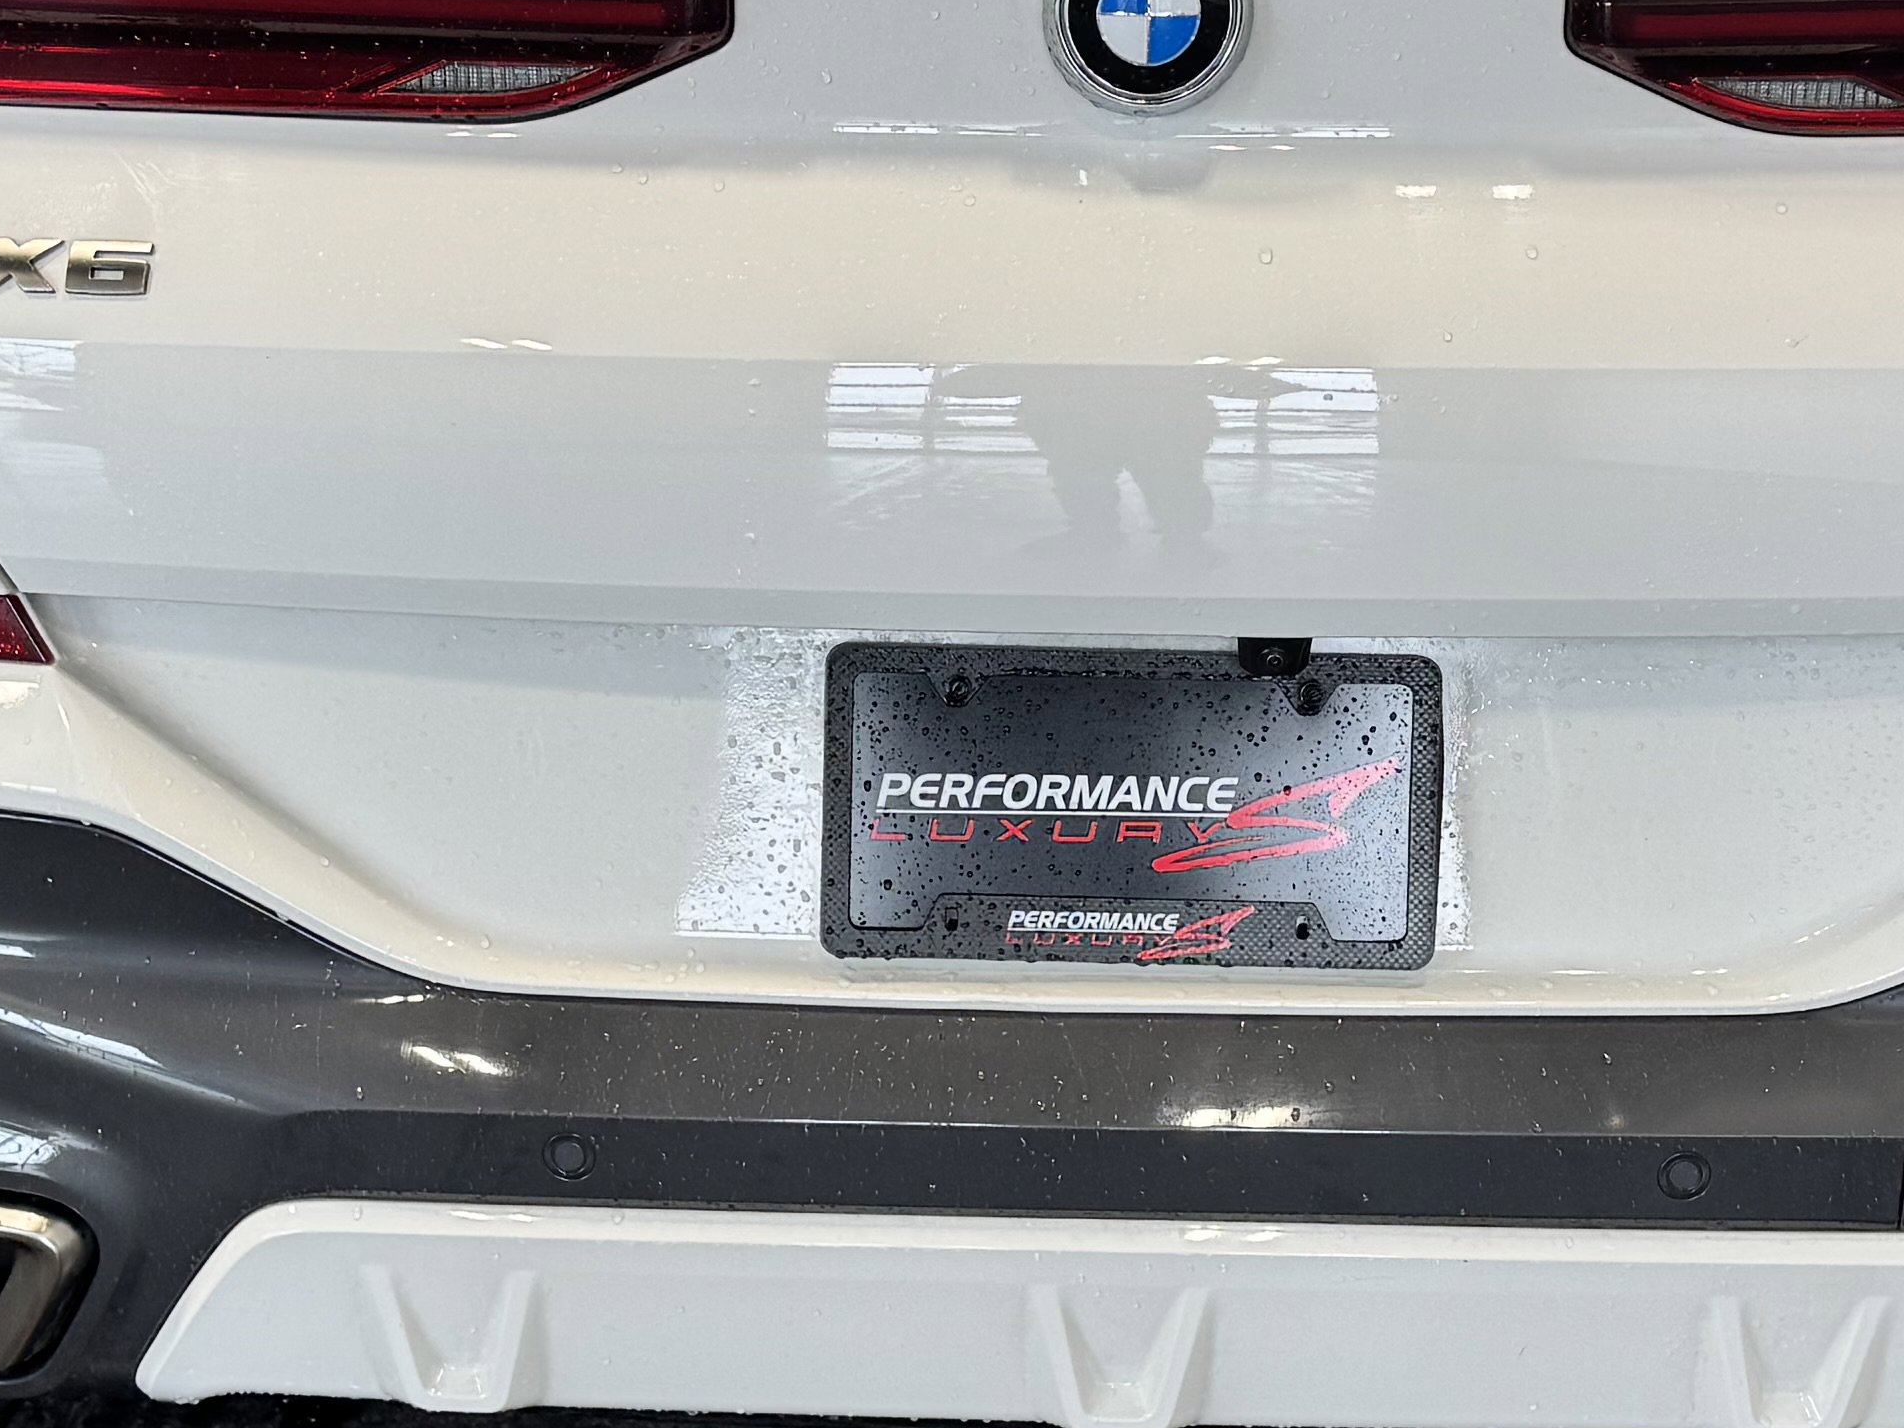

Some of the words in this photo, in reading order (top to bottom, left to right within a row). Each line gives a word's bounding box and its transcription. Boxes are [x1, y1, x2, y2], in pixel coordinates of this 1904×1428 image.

[876, 772, 1239, 812] PERFORMANCE
[869, 818, 1226, 844] LUXURY
[1007, 910, 1180, 931] PERFORMANCE
[1005, 932, 1173, 947] LUXURY
